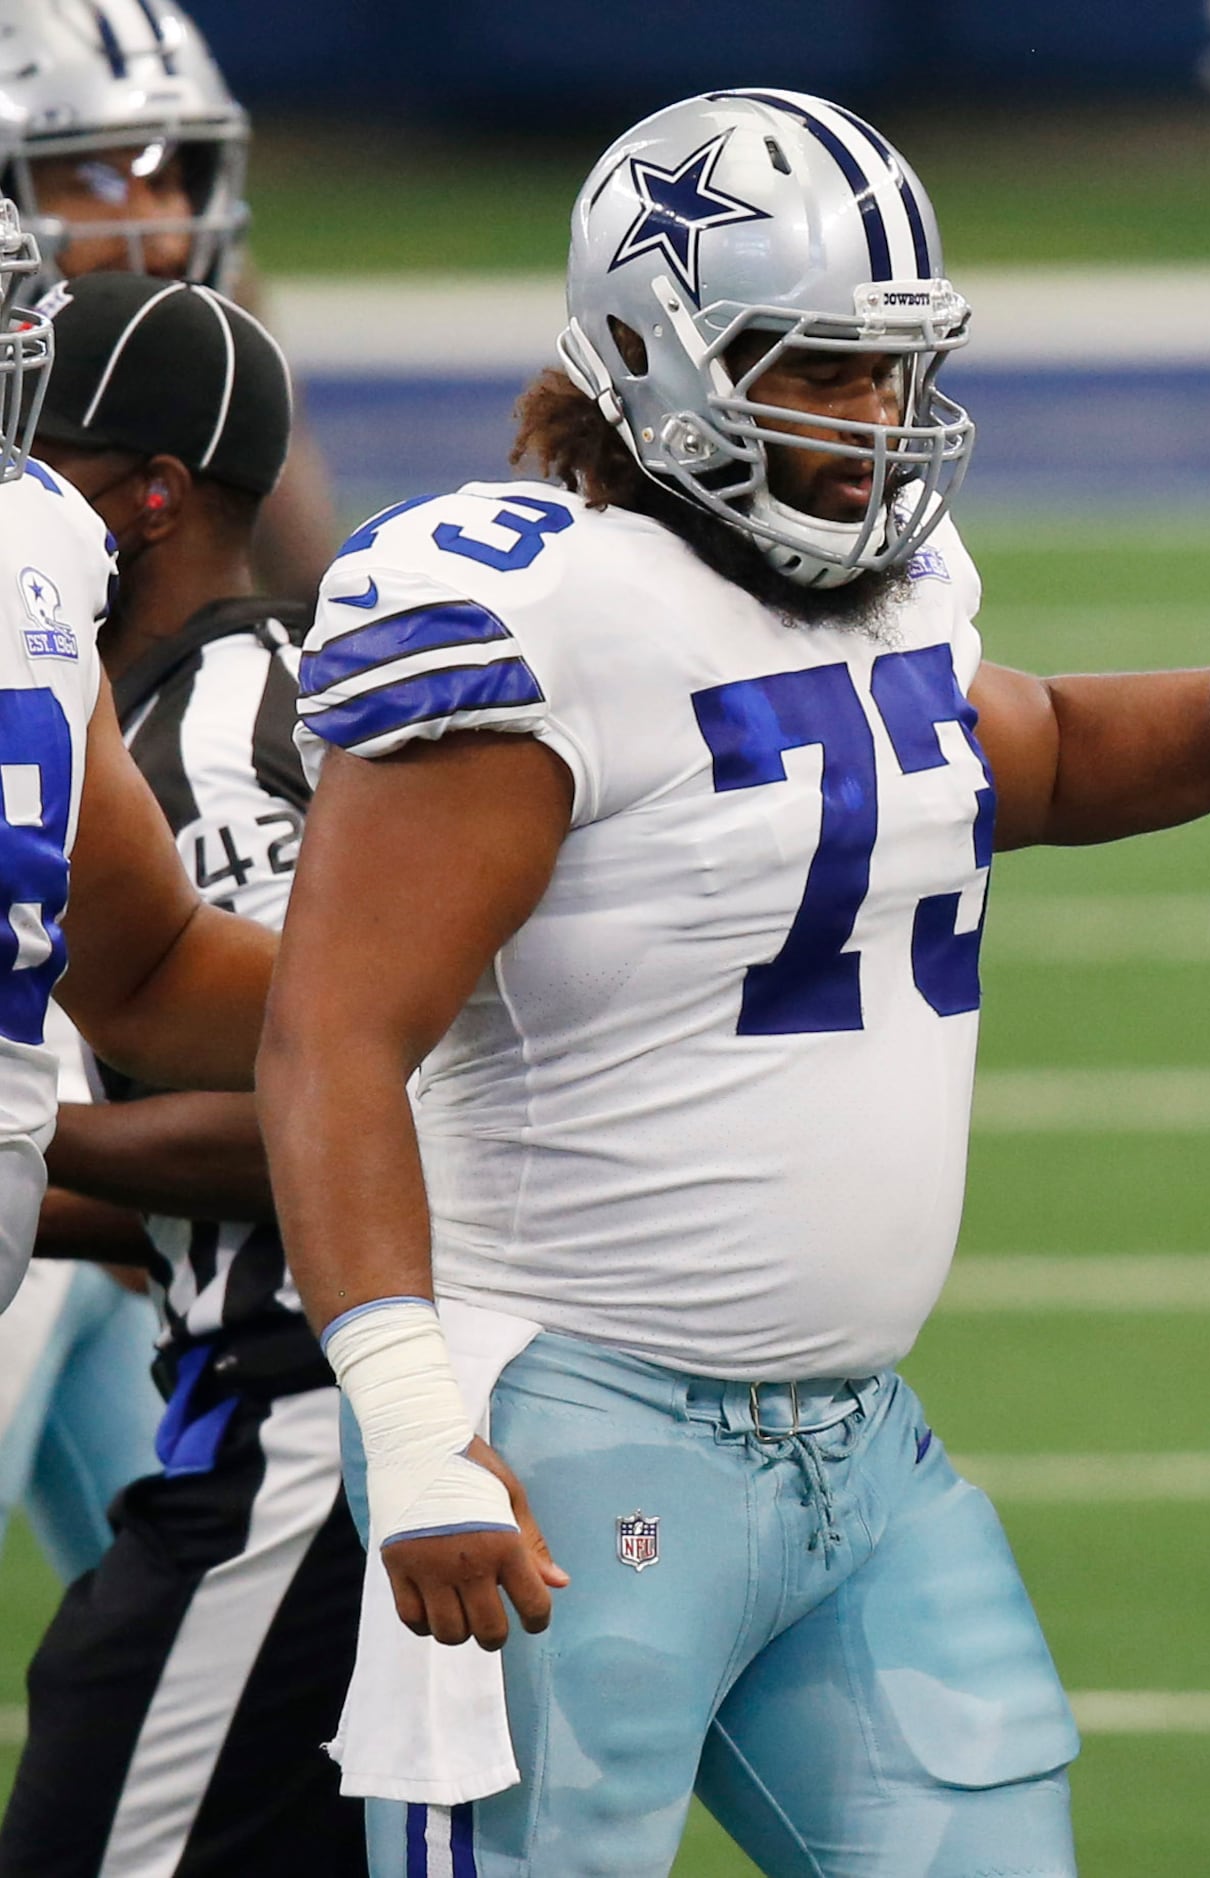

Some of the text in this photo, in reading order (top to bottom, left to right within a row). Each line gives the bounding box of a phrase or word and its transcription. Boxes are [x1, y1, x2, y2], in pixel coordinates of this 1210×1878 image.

[194, 808, 303, 889] 42
[690, 642, 997, 1036] 73
[624, 1537, 654, 1559] NFL
